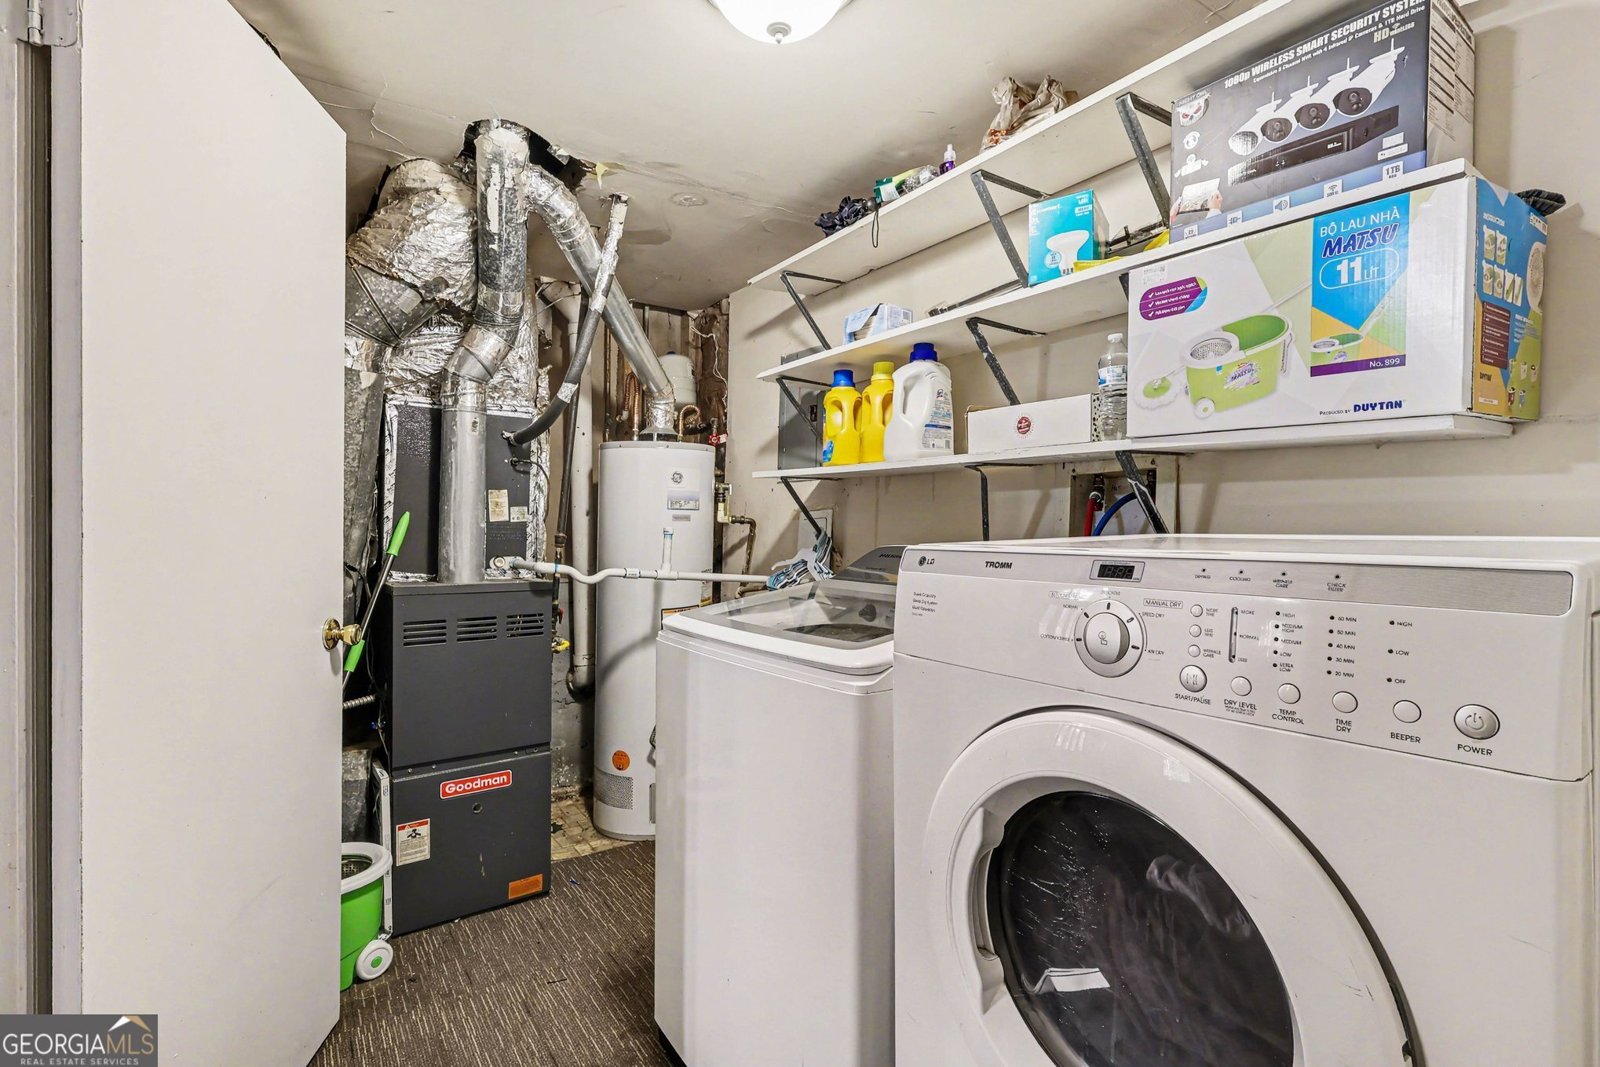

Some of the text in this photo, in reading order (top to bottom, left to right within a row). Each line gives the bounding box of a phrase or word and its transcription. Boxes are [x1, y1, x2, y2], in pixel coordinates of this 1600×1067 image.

[1354, 25, 1378, 39] Cameras
[1396, 12, 1410, 21] Hard
[1410, 5, 1426, 16] Drive
[1373, 27, 1390, 43] HD
[1224, 0, 1426, 89] 1080p WIRELESS SMART SECURITY SYSTE
[1320, 206, 1400, 238] BỘ LAU NHÀ
[1321, 222, 1400, 259] MATSU
[1336, 256, 1362, 285] 11
[1369, 357, 1401, 368] No. 899
[1353, 400, 1403, 413] DUYTAN
[985, 560, 1013, 570] TROMM
[1174, 693, 1212, 706] START/PAUSE
[1223, 698, 1238, 706] DRY
[1238, 701, 1258, 711] LEVEL
[1279, 708, 1297, 716] TEMP
[1271, 713, 1305, 725] CONTROL
[1335, 718, 1352, 727] TIME
[1336, 725, 1352, 733] DRY
[1390, 731, 1421, 744] BEEPER
[1457, 743, 1493, 757] POWER
[445, 774, 508, 794] Goodman
